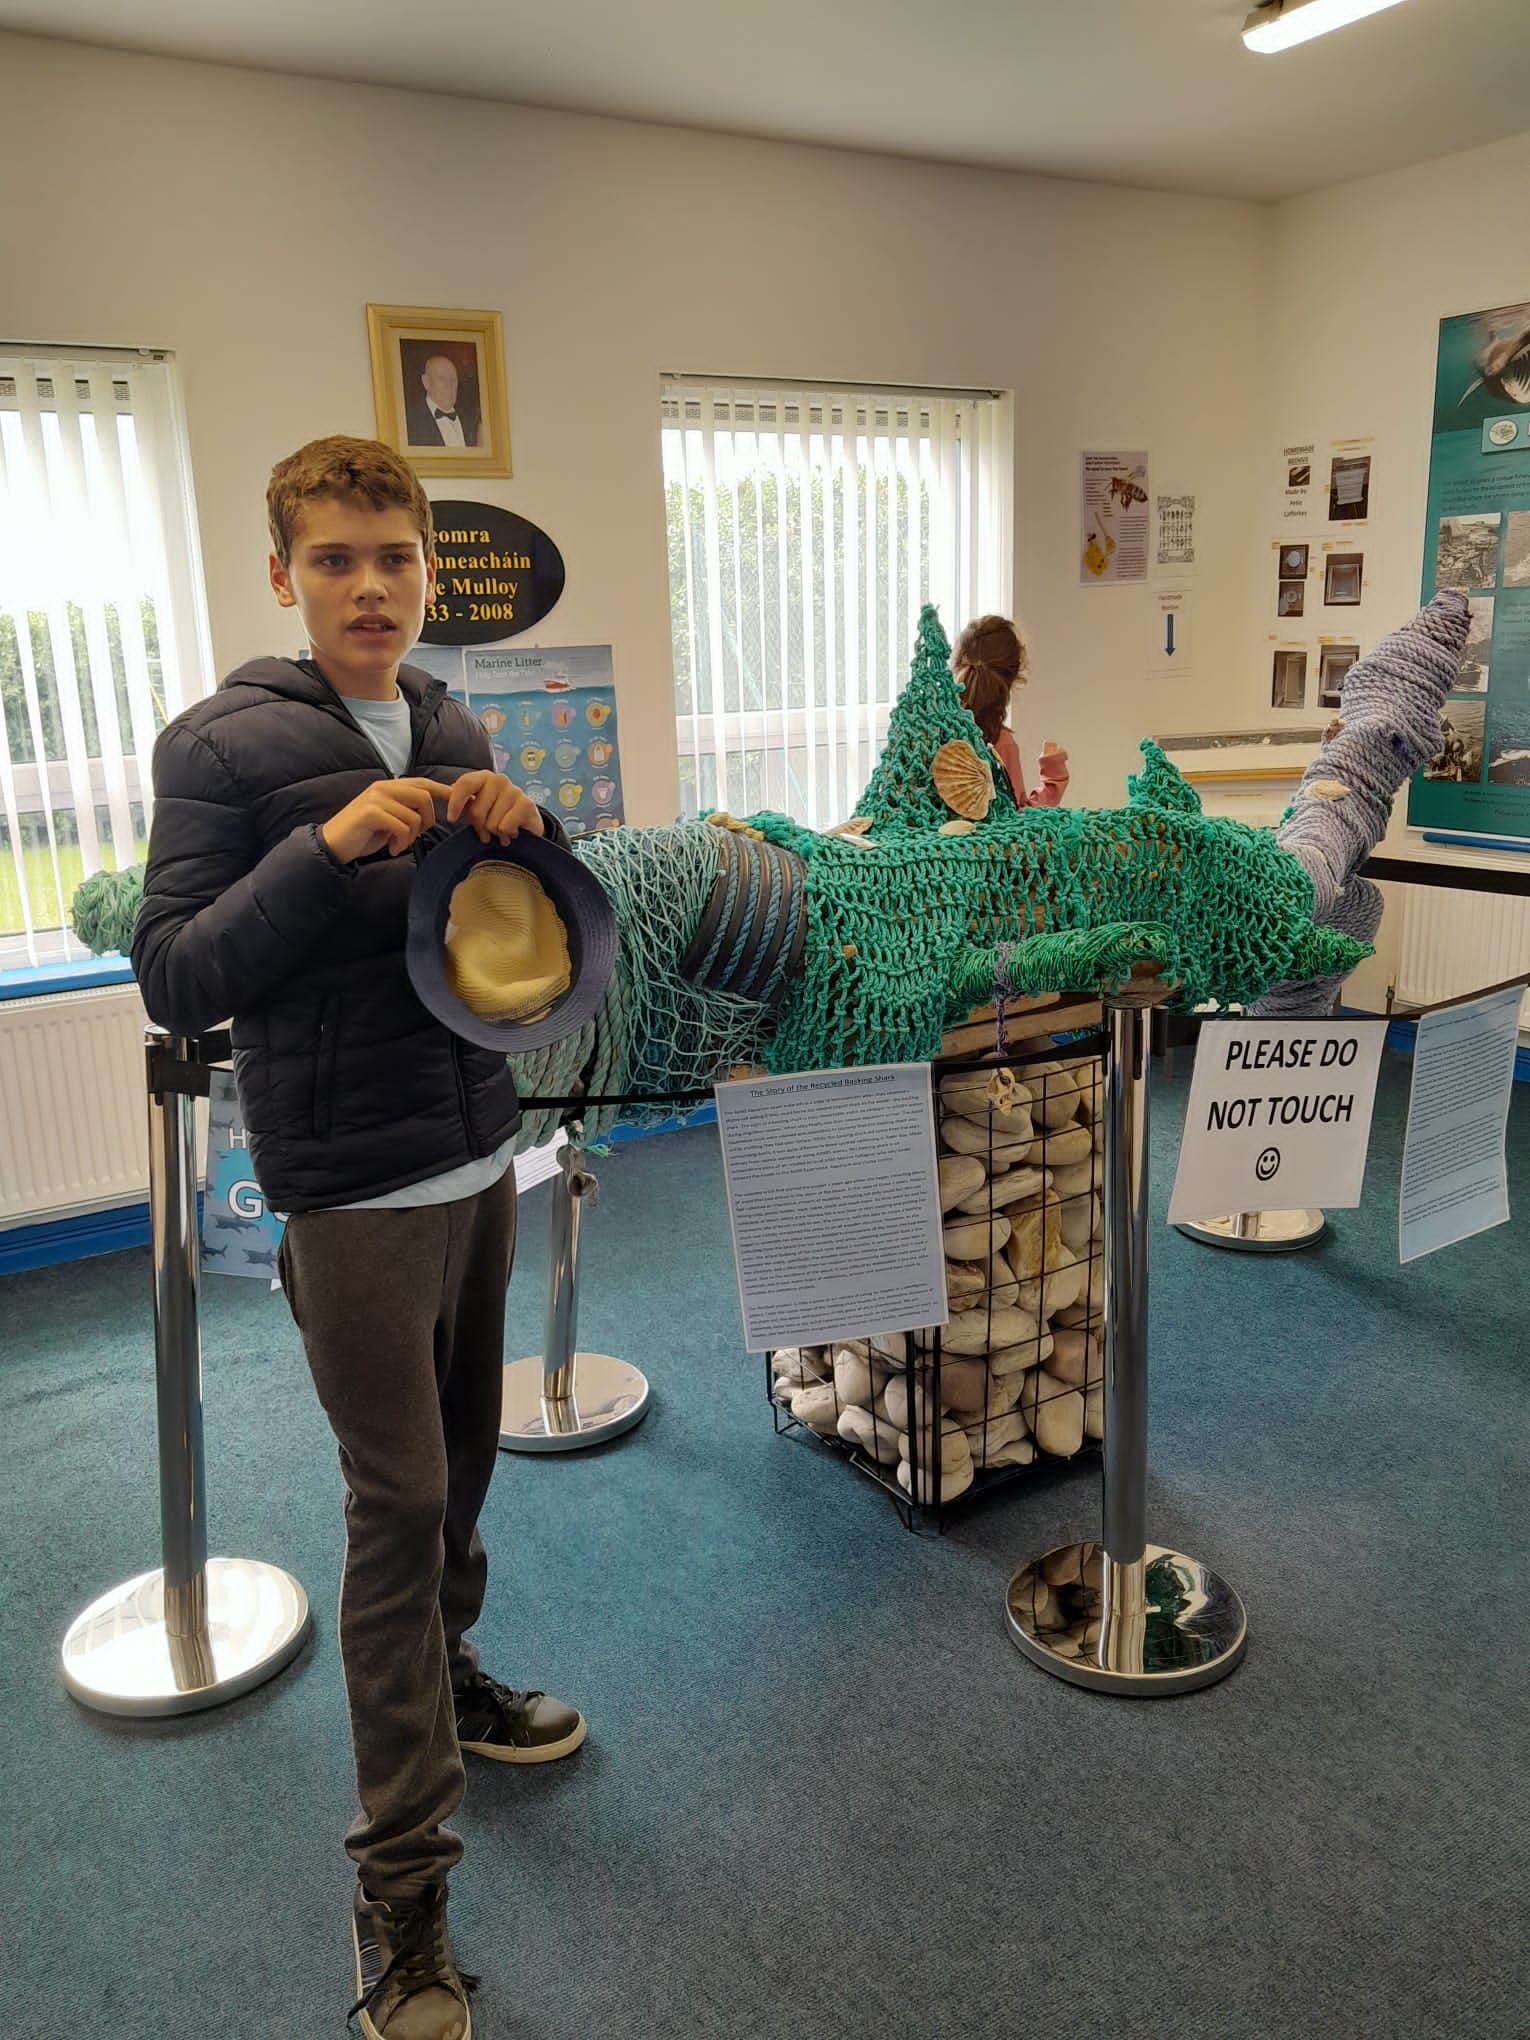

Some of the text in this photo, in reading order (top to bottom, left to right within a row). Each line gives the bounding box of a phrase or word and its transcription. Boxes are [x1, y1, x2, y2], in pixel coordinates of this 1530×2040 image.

[432, 529, 491, 543] eomra
[436, 577, 518, 599] e Mulloy
[427, 603, 450, 622] 33
[469, 603, 514, 621] 2008
[474, 656, 543, 670] Marine Litter
[1225, 1038, 1359, 1071] PLEASE DO
[750, 1073, 896, 1097] The Story of the Recycled Basking Shark
[1207, 1094, 1354, 1131] NOT TOUCH
